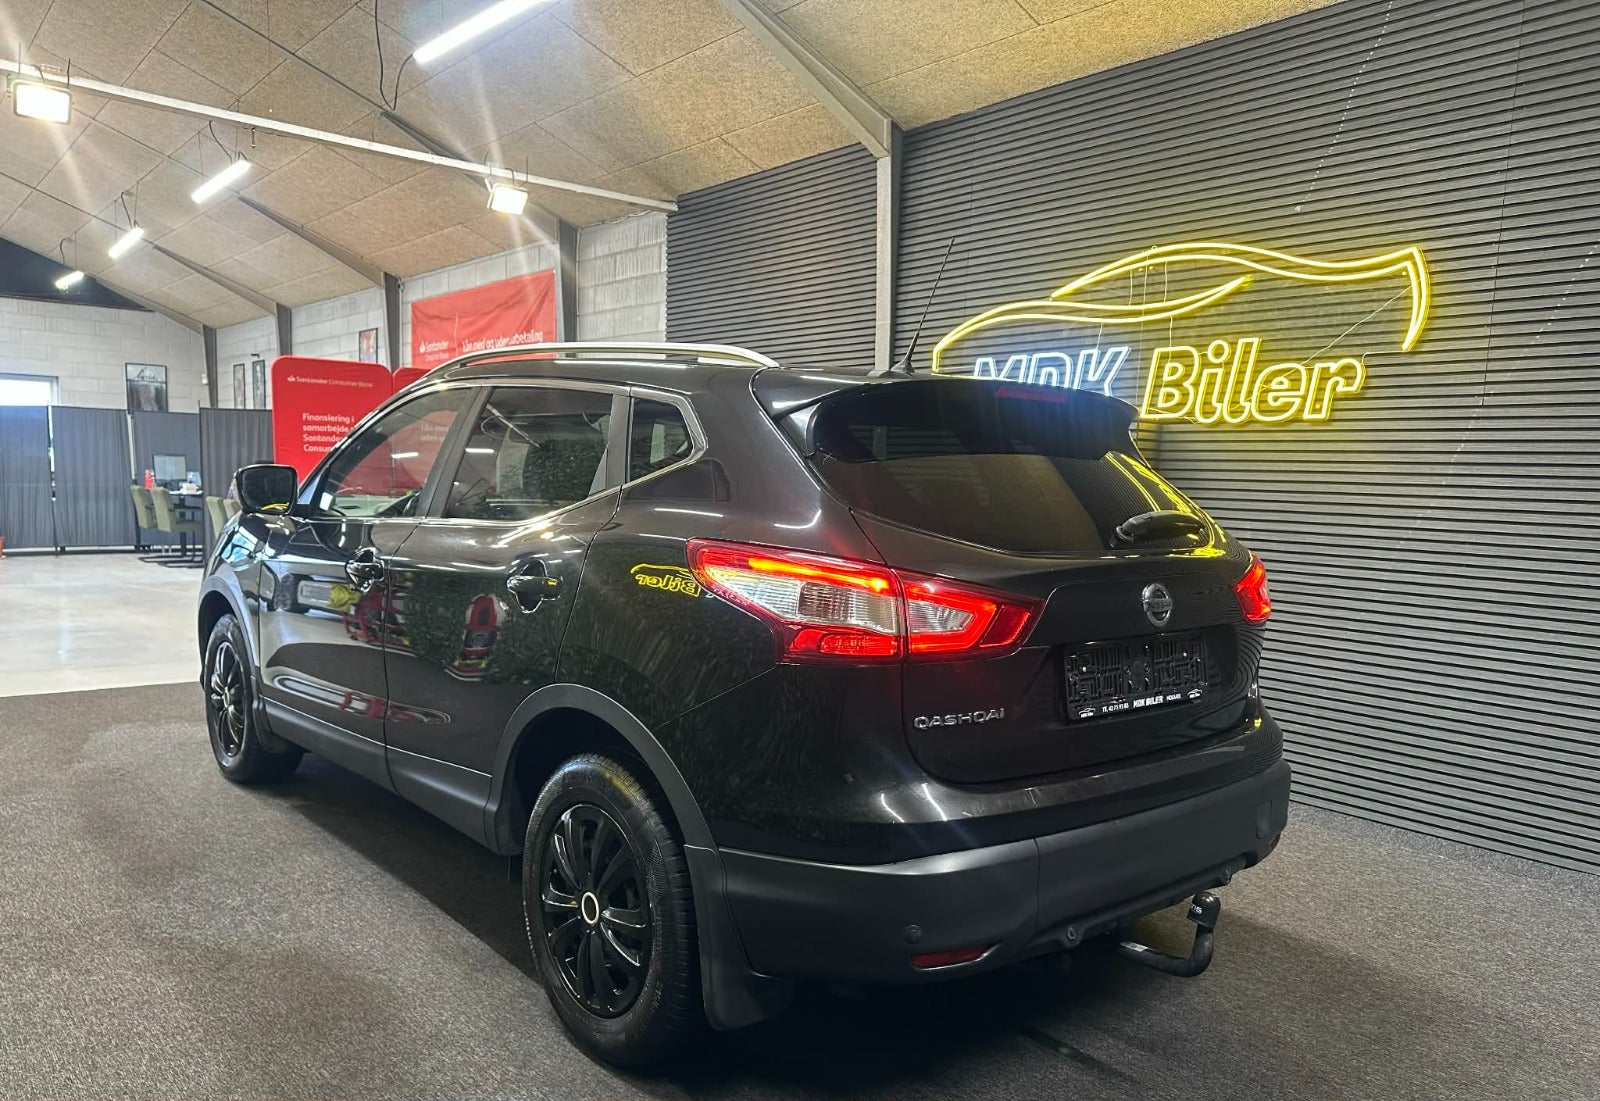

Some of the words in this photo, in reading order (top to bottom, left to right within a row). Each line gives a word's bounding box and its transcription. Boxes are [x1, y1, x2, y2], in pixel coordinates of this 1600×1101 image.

[296, 376, 328, 384] Santander
[328, 379, 358, 387] Consumer
[1139, 337, 1366, 423] Biler
[302, 413, 350, 423] Finansiering
[351, 415, 355, 423] i
[302, 424, 349, 434] samarbejde
[1146, 696, 1163, 706] BILER
[914, 708, 1005, 729] QASHQAI
